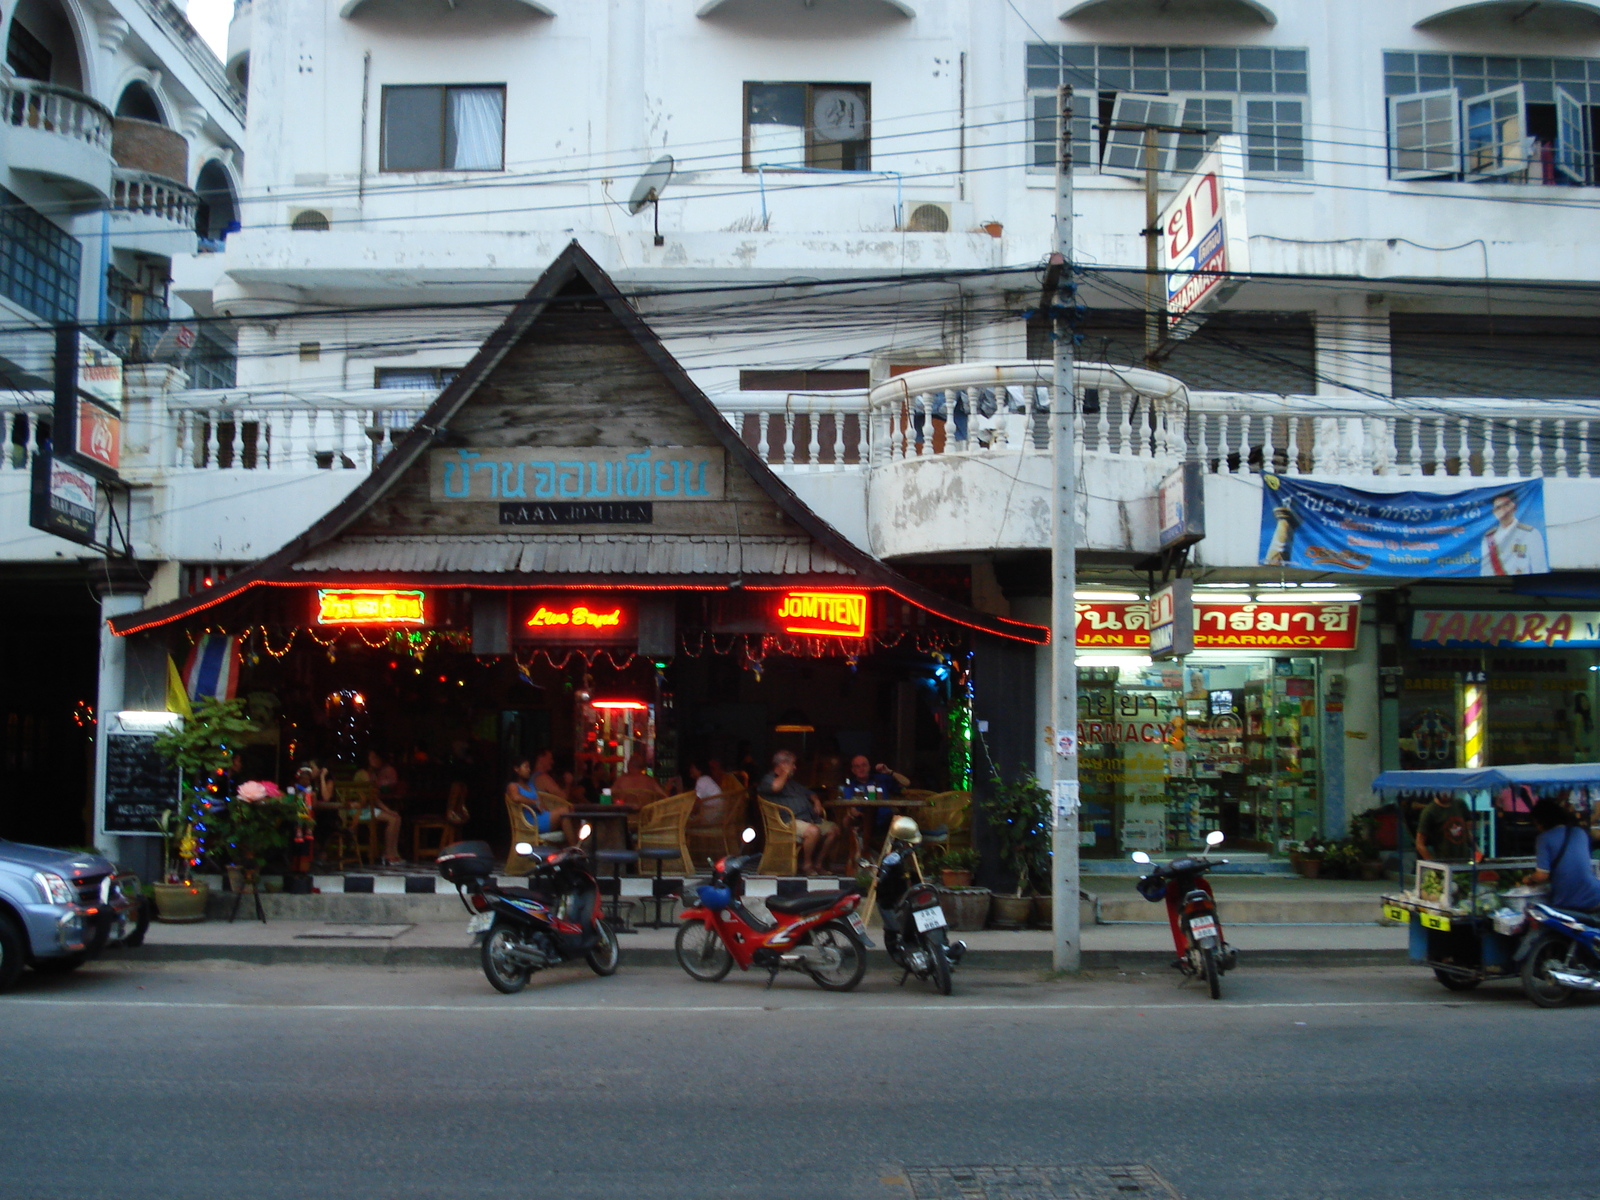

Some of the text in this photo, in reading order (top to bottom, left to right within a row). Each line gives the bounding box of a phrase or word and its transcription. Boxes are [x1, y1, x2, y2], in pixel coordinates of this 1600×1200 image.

[1168, 171, 1219, 260] ยา
[443, 449, 710, 498] บ้านจอมเทียน
[778, 596, 860, 626] JOMTIEN
[1076, 634, 1124, 644] JAN
[1193, 634, 1328, 645] PHARMACY
[1421, 612, 1573, 647] TAKARA
[1077, 723, 1174, 743] ARMACY
